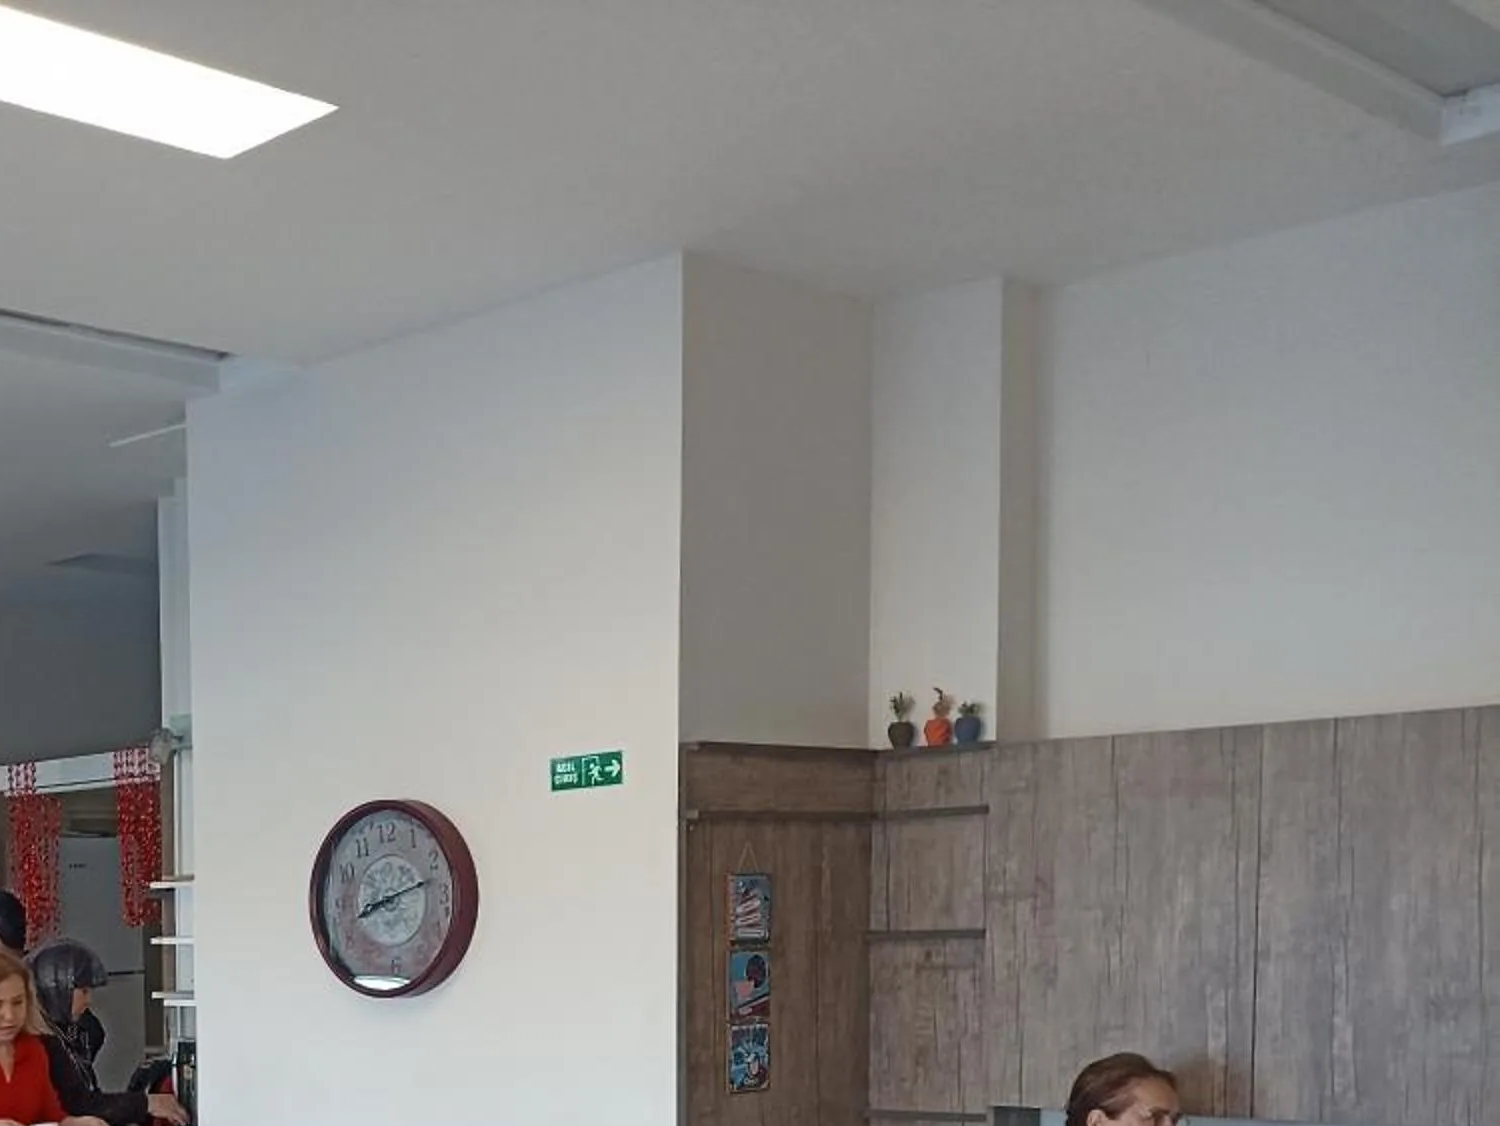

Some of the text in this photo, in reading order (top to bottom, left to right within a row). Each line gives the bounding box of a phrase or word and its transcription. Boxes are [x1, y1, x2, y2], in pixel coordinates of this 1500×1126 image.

[377, 822, 397, 844] 12
[409, 828, 417, 849] 1
[355, 837, 370, 858] 11
[427, 849, 439, 870] 2
[339, 862, 355, 884] 10
[439, 882, 450, 906] 3
